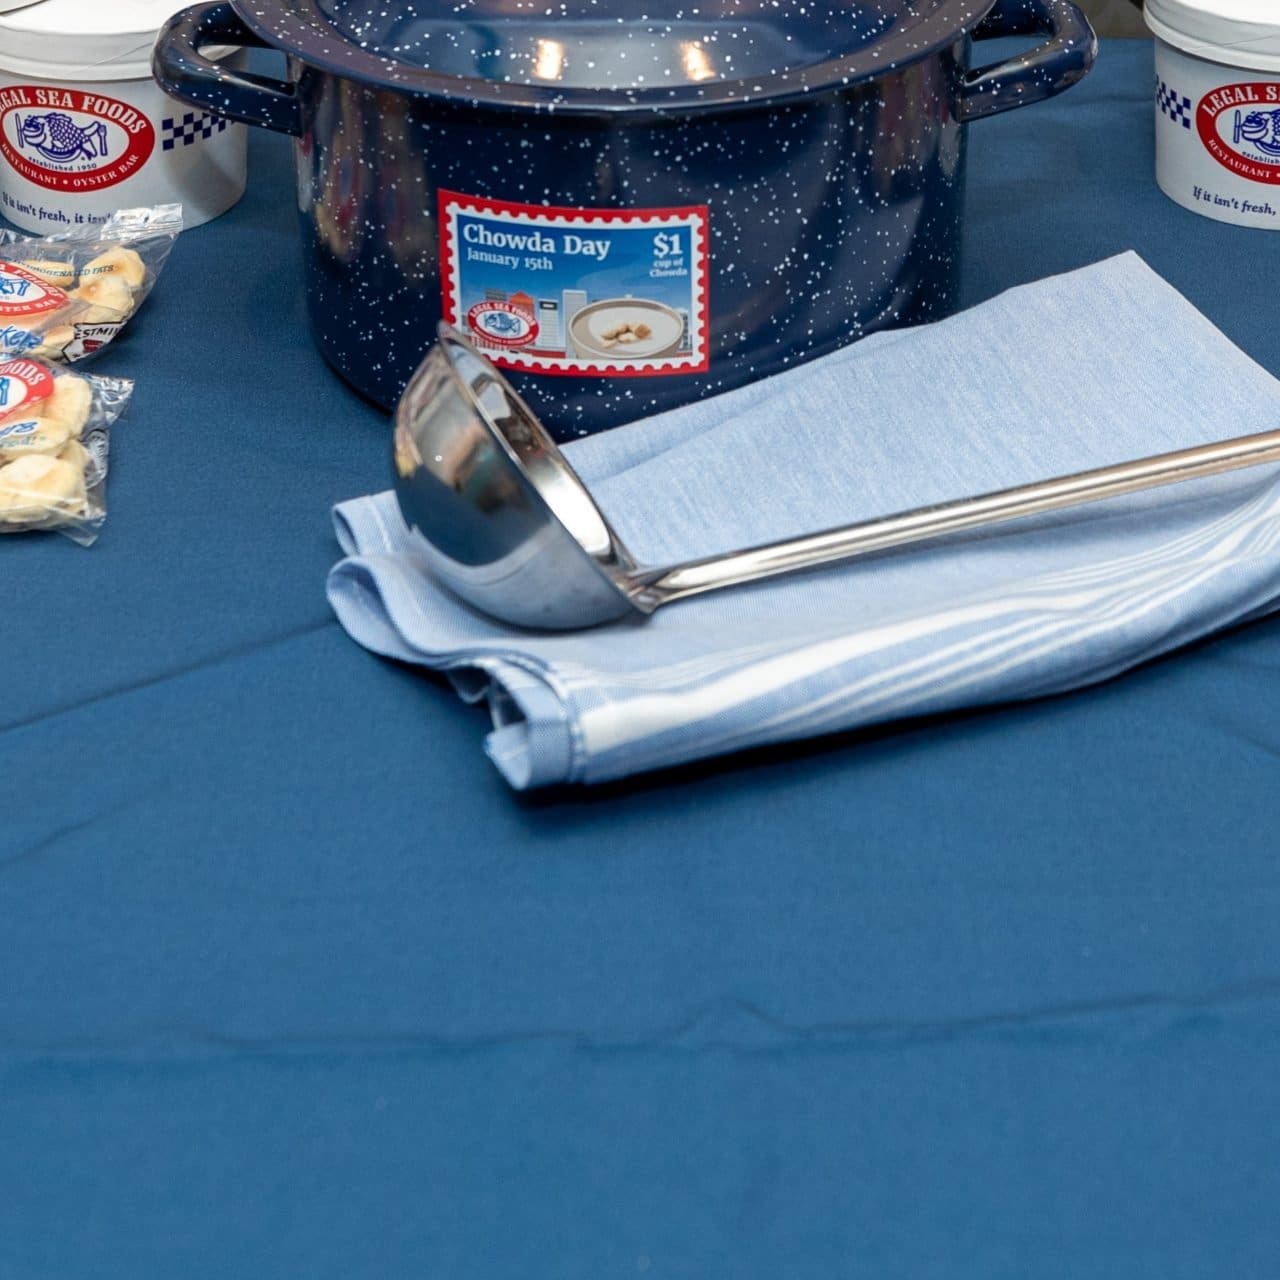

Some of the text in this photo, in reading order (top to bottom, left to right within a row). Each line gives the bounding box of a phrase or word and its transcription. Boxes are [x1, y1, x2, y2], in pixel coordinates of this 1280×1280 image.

[35, 90, 73, 108] SEA
[82, 96, 147, 134] FOODS
[1202, 86, 1258, 117] LEGAL
[74, 171, 117, 187] OYSTER
[118, 154, 139, 175] BAR
[1208, 139, 1271, 178] RESTAURANT
[1194, 186, 1276, 216] If it isn't fresh,
[463, 224, 610, 260] Chowda Day
[654, 232, 683, 258] $1
[468, 248, 552, 270] January 15th
